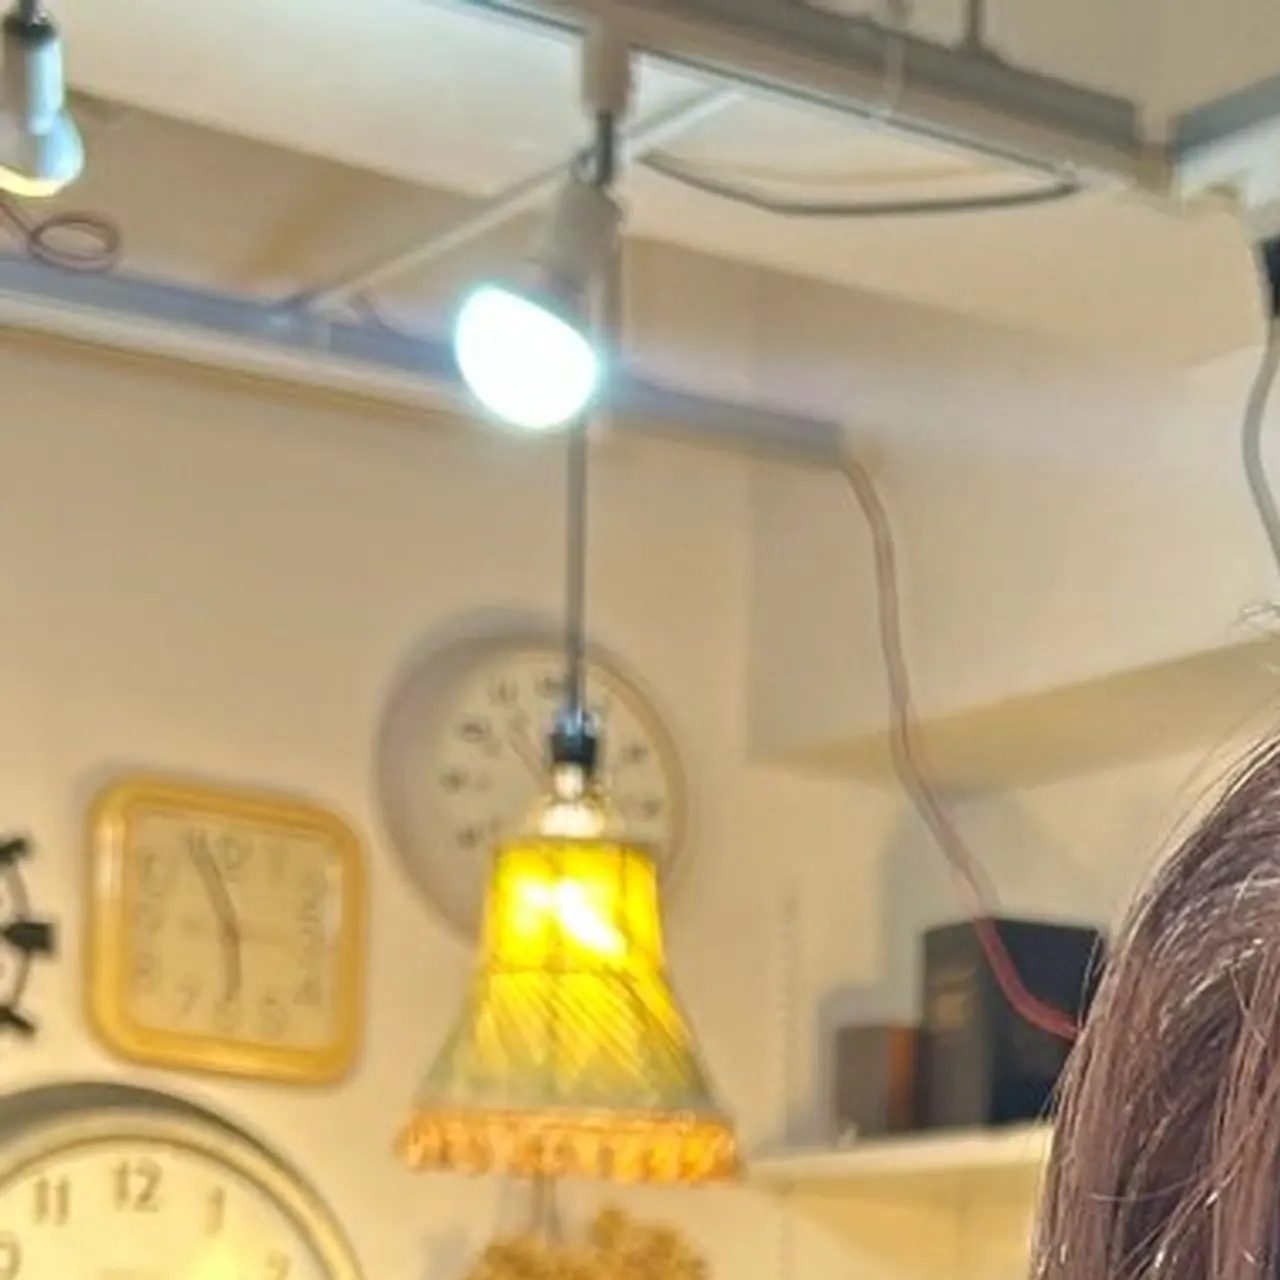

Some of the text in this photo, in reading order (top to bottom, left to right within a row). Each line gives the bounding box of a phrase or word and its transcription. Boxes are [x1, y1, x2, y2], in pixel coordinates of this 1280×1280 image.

[34, 1177, 71, 1226] 11
[114, 1160, 163, 1213] 12
[207, 1186, 226, 1237] 1
